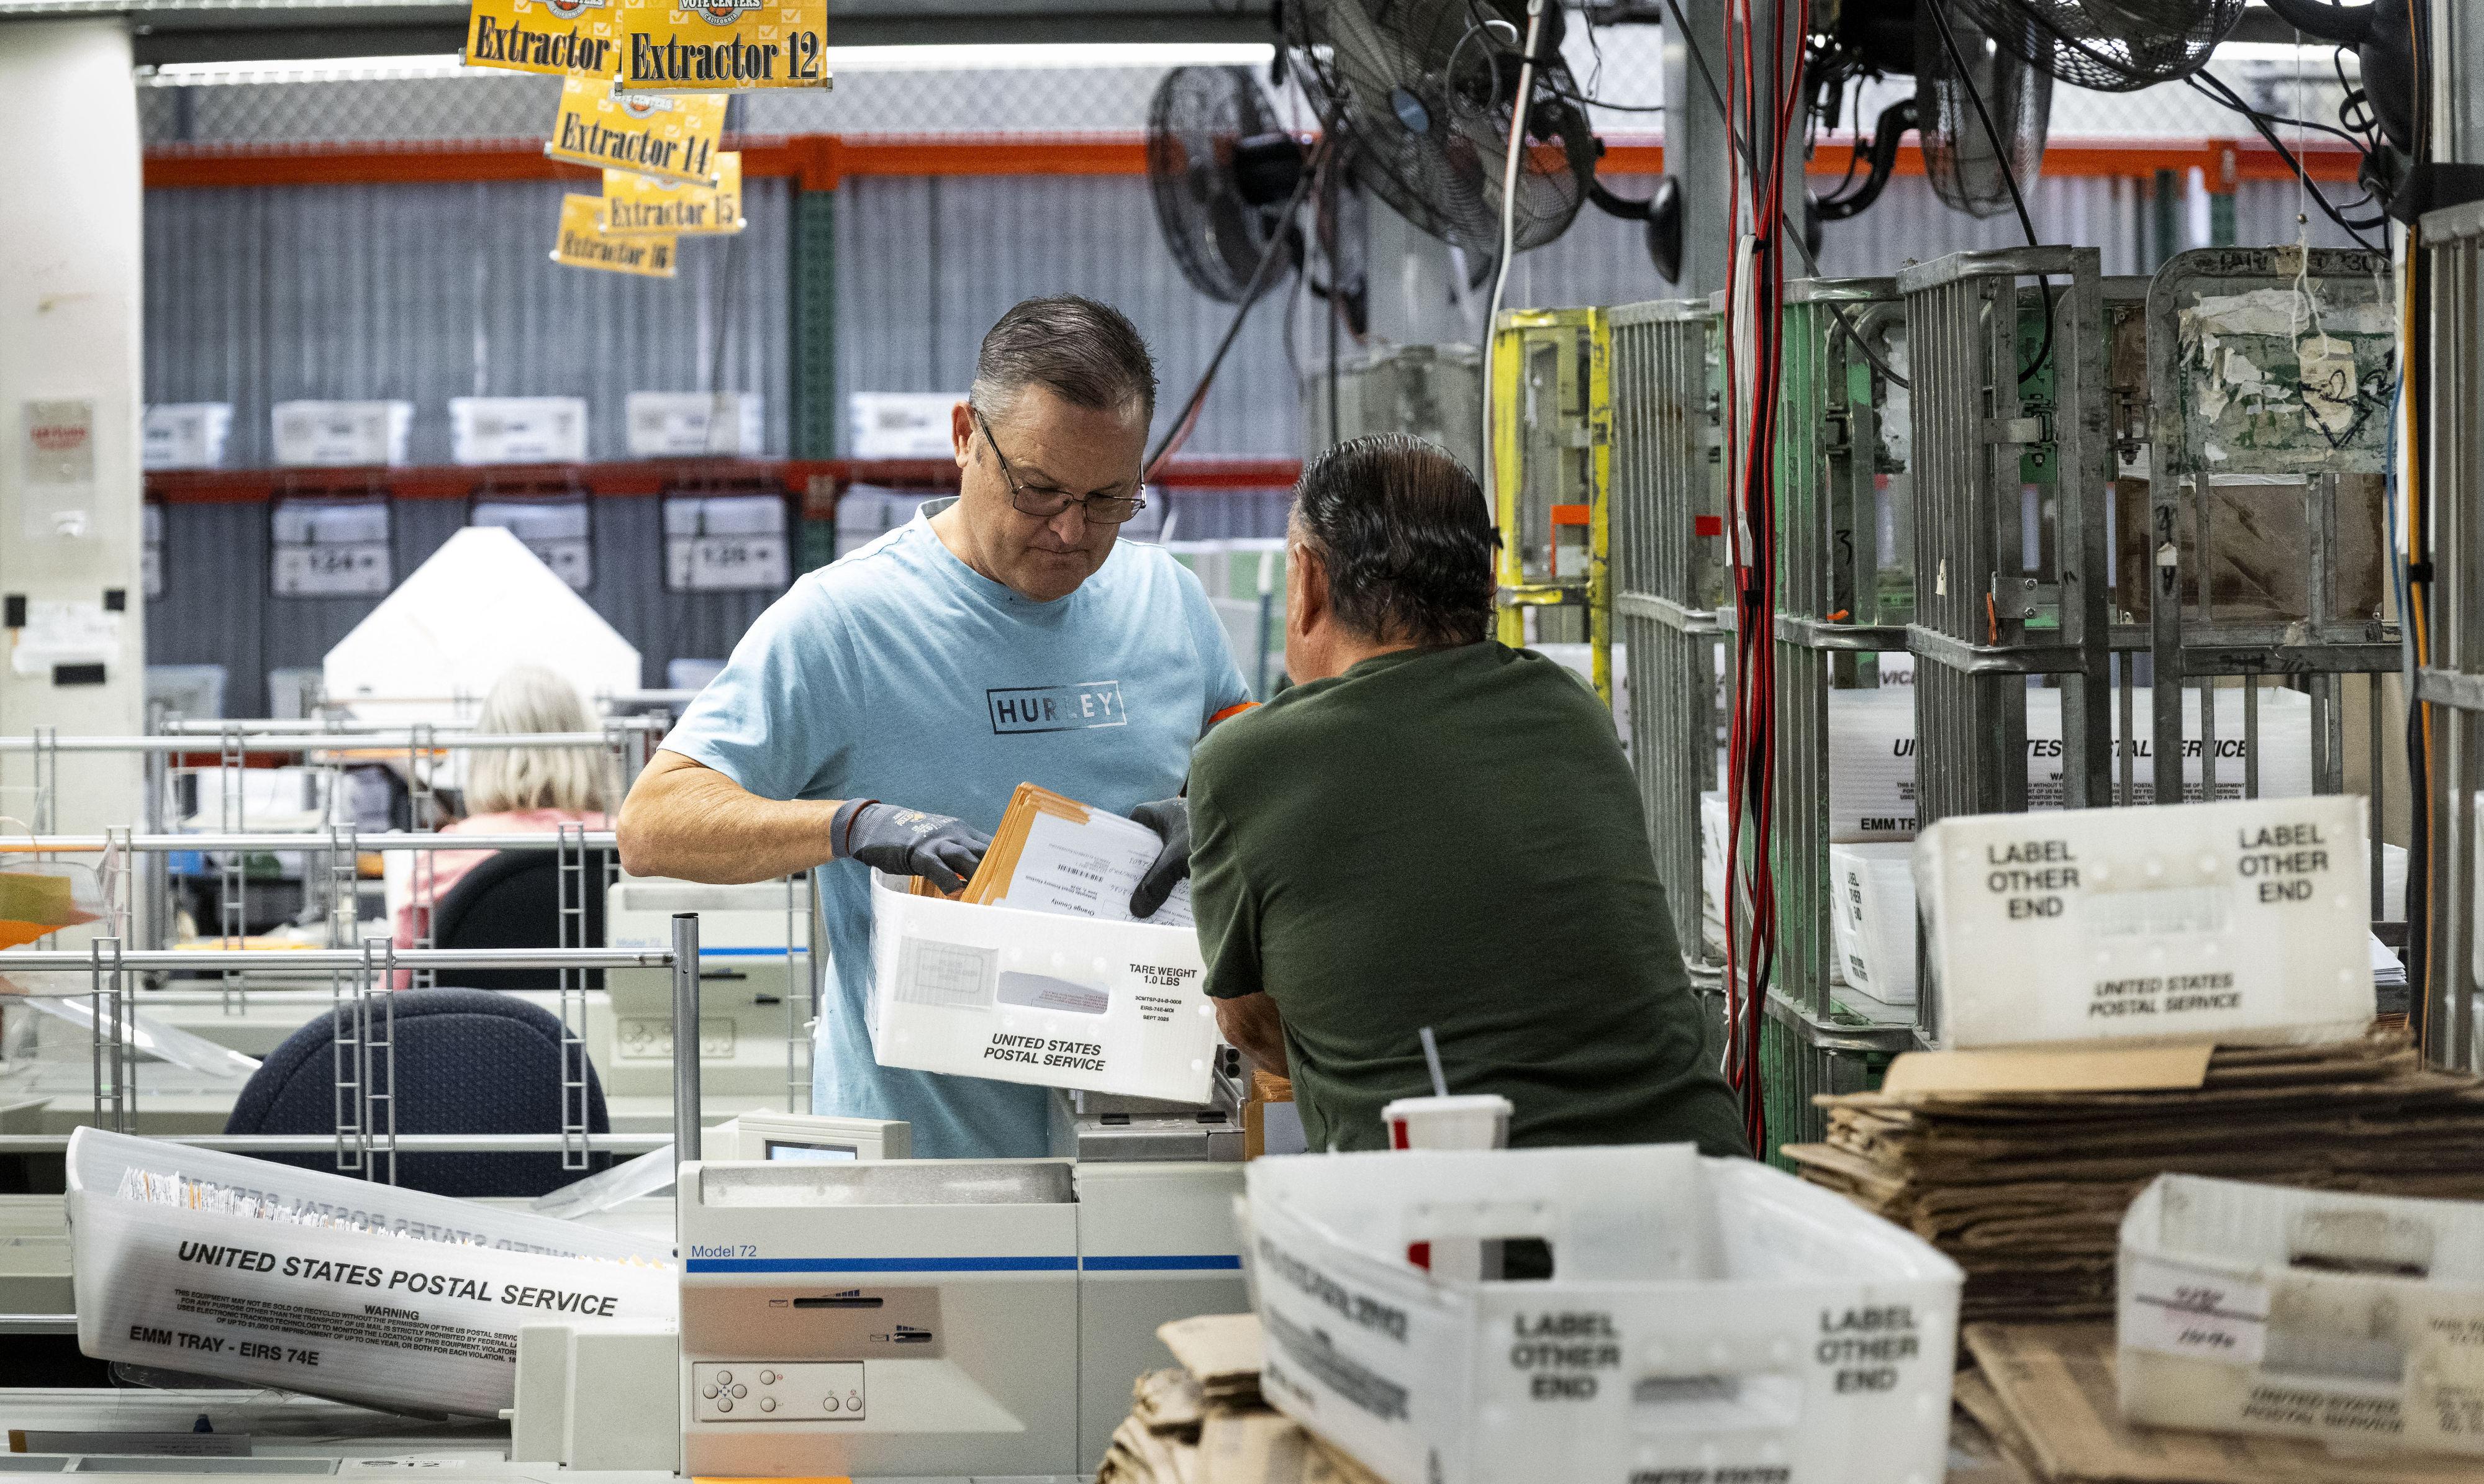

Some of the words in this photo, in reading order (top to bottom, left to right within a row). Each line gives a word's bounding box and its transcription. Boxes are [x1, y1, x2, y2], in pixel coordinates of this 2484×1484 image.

[704, 13, 738, 24] CALIFORNIA
[473, 15, 610, 71] Extractor
[630, 32, 779, 81] Extractor
[787, 30, 819, 80] 12
[560, 111, 678, 168] Extractor
[683, 135, 710, 176] 14
[611, 196, 707, 227] Extractor
[715, 193, 733, 225] 15
[997, 692, 1115, 723] HURLEY
[1861, 818, 1896, 830] EMM
[2237, 823, 2326, 849] LABEL
[1987, 841, 2076, 865] LABEL
[2237, 851, 2329, 877] OTHER
[1043, 880, 1061, 889] Primary
[1987, 869, 2080, 894] OTHER
[2258, 880, 2313, 903] END
[1051, 898, 1072, 910] County
[1073, 904, 1095, 916] Orange
[2008, 897, 2064, 920] END
[1130, 964, 1156, 975] TARE
[1158, 967, 1197, 979] WEIGHT
[1144, 975, 1158, 984] 1.0
[1160, 976, 1180, 986] LBS
[2094, 977, 2162, 997] UNITED
[2169, 973, 2234, 992] STATES
[1140, 1005, 1174, 1013] EIRS-74E-MDI
[2088, 997, 2157, 1017] POSTAL
[2165, 992, 2242, 1013] SERVICE
[992, 1033, 1045, 1049] UNITED
[1048, 1039, 1102, 1056] STATES
[984, 1047, 1039, 1064] POSTAL
[1043, 1054, 1106, 1071] SERVICE
[692, 1245, 735, 1257] Model
[739, 1245, 757, 1257] 72
[178, 1241, 276, 1273] UNITED
[283, 1256, 382, 1287] STATES
[389, 1270, 493, 1302] POSTAL
[501, 1284, 619, 1317] SERVICE
[191, 1292, 230, 1303] EQUIPMENT
[273, 1303, 292, 1311] SOLD
[304, 1308, 340, 1318] RECYCLED
[342, 1313, 372, 1322] WITHOUT
[388, 1319, 429, 1329] PERMISSION
[466, 1329, 492, 1337] POSTAL
[494, 1333, 517, 1341] SERVIC
[212, 1301, 245, 1312] PURPOSE
[246, 1306, 268, 1315] OTHER
[303, 1314, 343, 1325] TRANSPORT
[392, 1326, 424, 1336] STRICTLY
[425, 1331, 466, 1341] PROHIBITED
[478, 1338, 508, 1347] FEDERAL
[365, 1305, 420, 1321] WARNING
[1513, 1311, 1616, 1339] LABEL
[1820, 1305, 1917, 1334] LABEL
[177, 1304, 195, 1313] USES
[196, 1307, 238, 1318] ELECTRONIC
[240, 1313, 273, 1323] TRACKING
[275, 1318, 321, 1330] TECHNOLOGY
[333, 1325, 363, 1335] MONITOR
[379, 1332, 412, 1341] LOCATION
[441, 1341, 481, 1350] EQUIPMENT.
[129, 1326, 173, 1346] EMM
[177, 1332, 224, 1352] TRAY
[239, 1341, 282, 1362] EIRS
[287, 1348, 320, 1365] 74E
[281, 1326, 332, 1338] IMPRISONMENT
[380, 1340, 400, 1349] YEAR,
[468, 1351, 505, 1362] VIOLATION,
[1509, 1343, 1621, 1370] OTHER
[1815, 1336, 1920, 1366] OTHER
[1530, 1375, 1598, 1401] END
[1834, 1368, 1898, 1394] END
